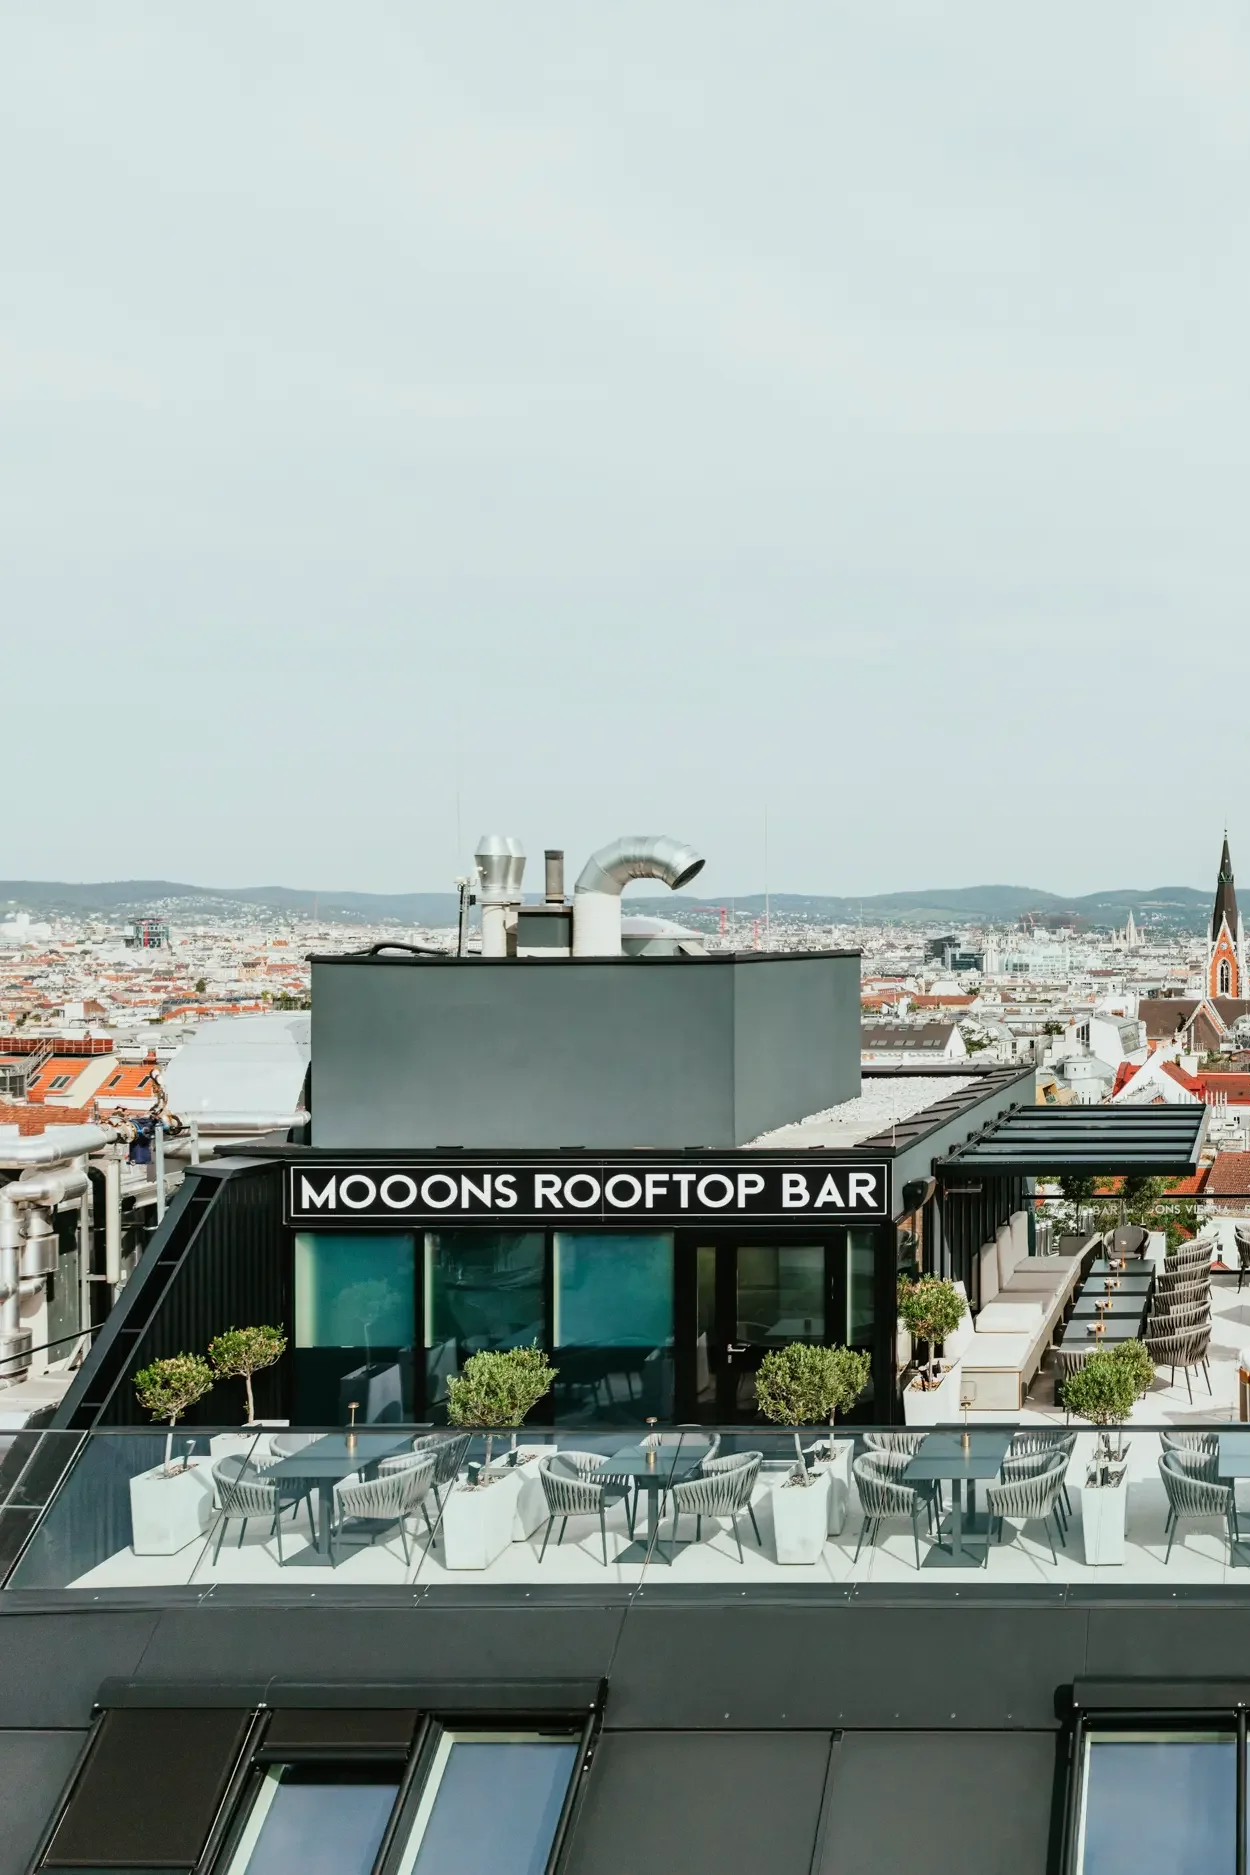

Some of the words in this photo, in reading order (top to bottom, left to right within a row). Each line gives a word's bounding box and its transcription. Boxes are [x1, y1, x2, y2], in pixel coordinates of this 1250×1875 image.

[301, 1174, 518, 1209] MOOONS
[534, 1173, 765, 1209] ROOFTOP
[782, 1172, 878, 1208] BAR
[1092, 1205, 1118, 1216] BAR
